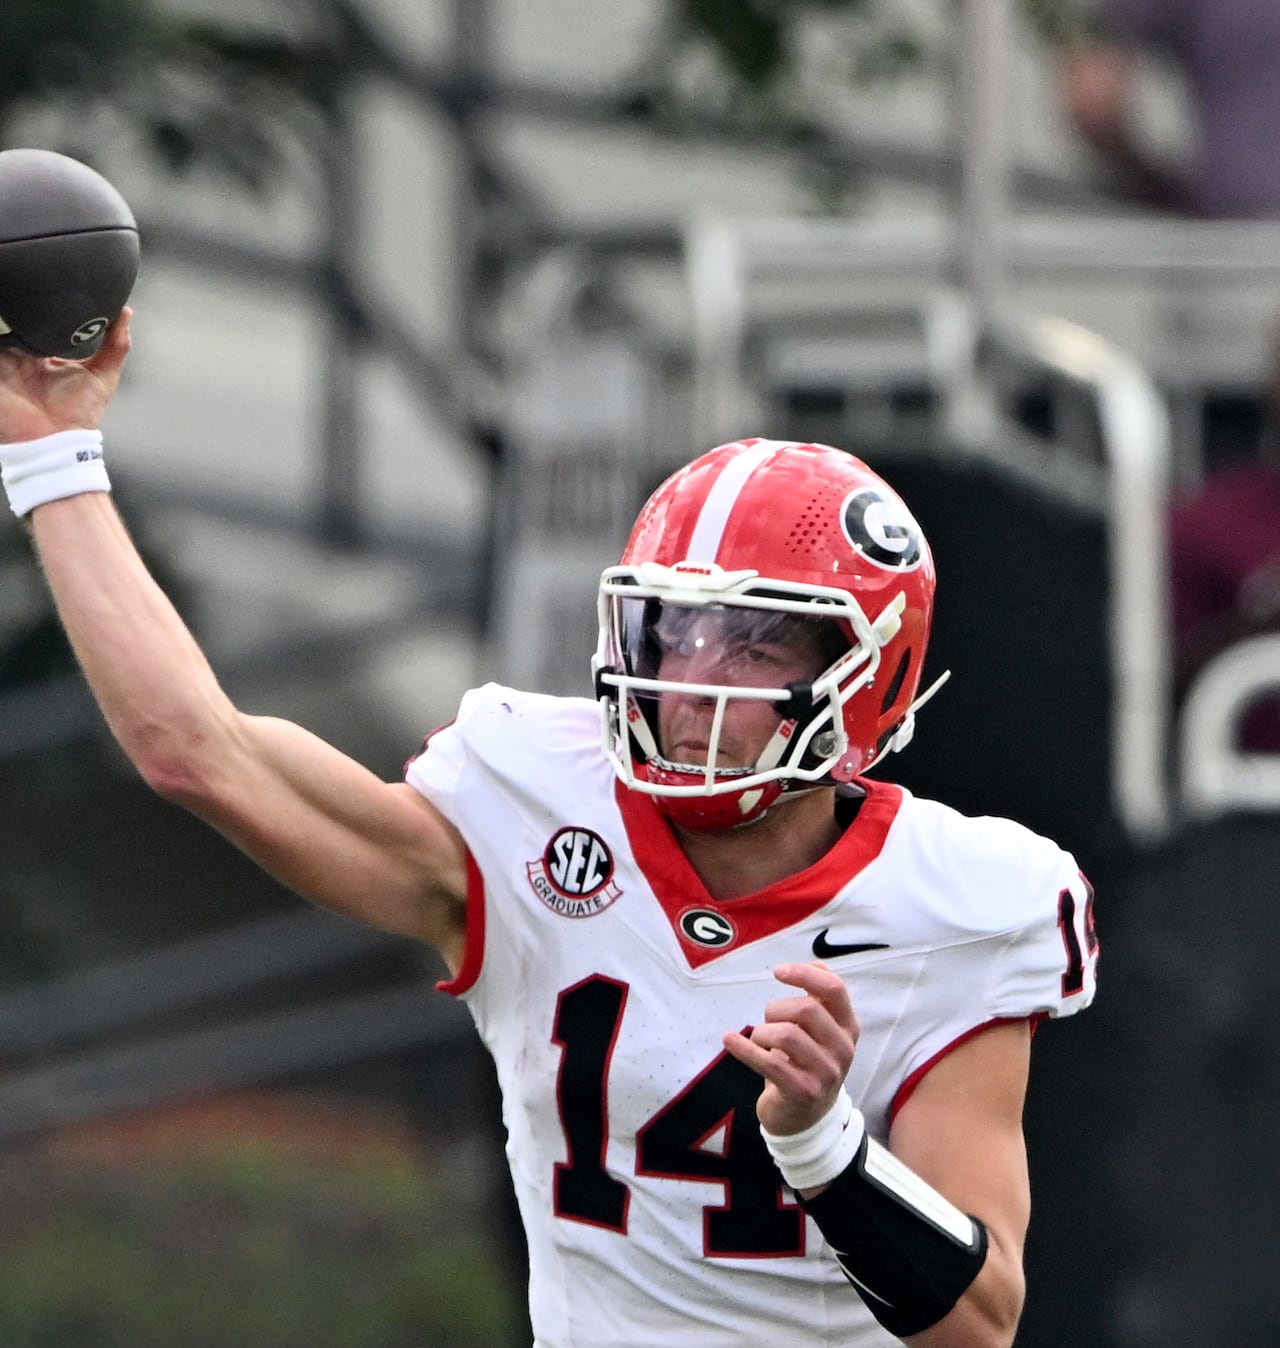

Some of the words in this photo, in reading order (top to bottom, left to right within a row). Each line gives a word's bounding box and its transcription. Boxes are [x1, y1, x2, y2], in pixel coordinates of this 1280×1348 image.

[841, 489, 922, 571] G
[549, 830, 608, 894] SEC
[534, 876, 604, 917] GRADUATE
[681, 910, 733, 947] G
[551, 973, 806, 1258] 14
